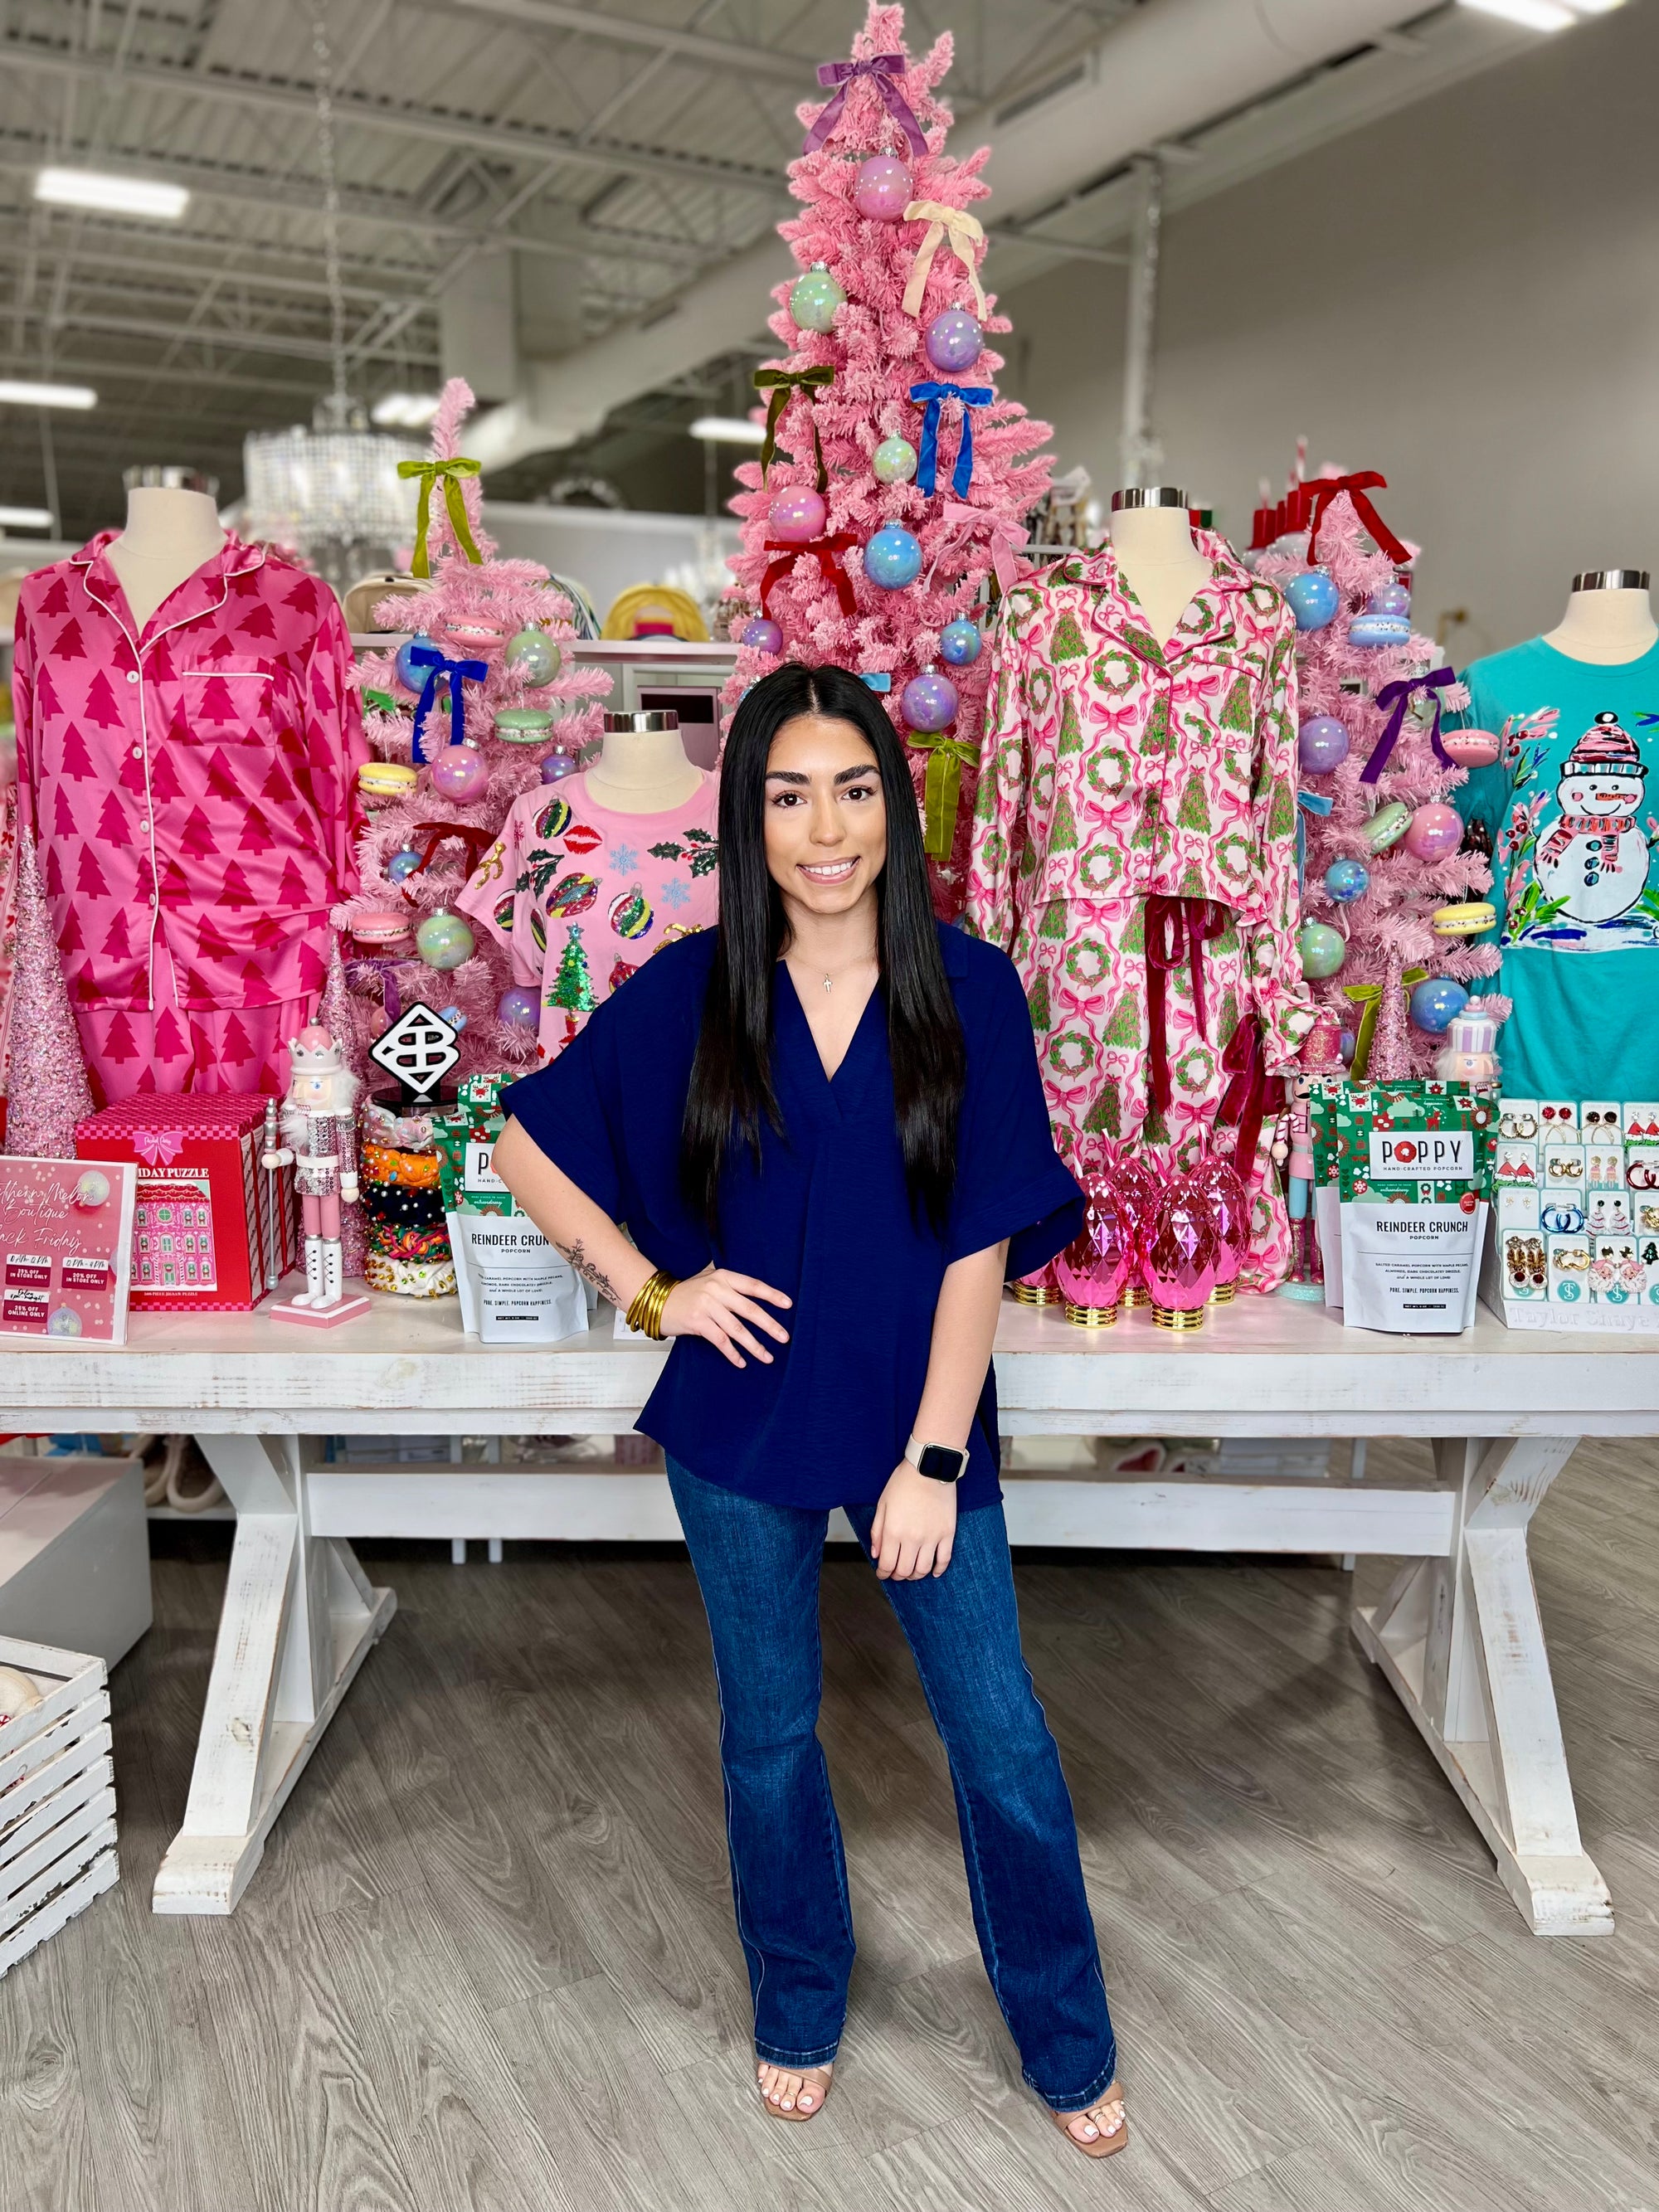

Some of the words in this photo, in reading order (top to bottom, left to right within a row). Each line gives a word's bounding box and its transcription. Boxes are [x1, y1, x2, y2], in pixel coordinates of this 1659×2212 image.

[1382, 1140, 1461, 1164] POPPY
[138, 1167, 166, 1178] IDAY
[167, 1167, 210, 1178] PUZZLE
[0, 1179, 45, 1203] thern
[45, 1182, 94, 1205] Melon
[3, 1198, 68, 1227] Boutique
[1376, 1221, 1425, 1232] REINDEER
[1429, 1221, 1468, 1232] CRUNCH
[0, 1224, 28, 1247] ack
[34, 1227, 82, 1257] Friday
[471, 1233, 517, 1246] REINDEER
[521, 1235, 549, 1247] CRUN
[1510, 1307, 1579, 1328] Taylor
[1586, 1309, 1650, 1331] Shaye
